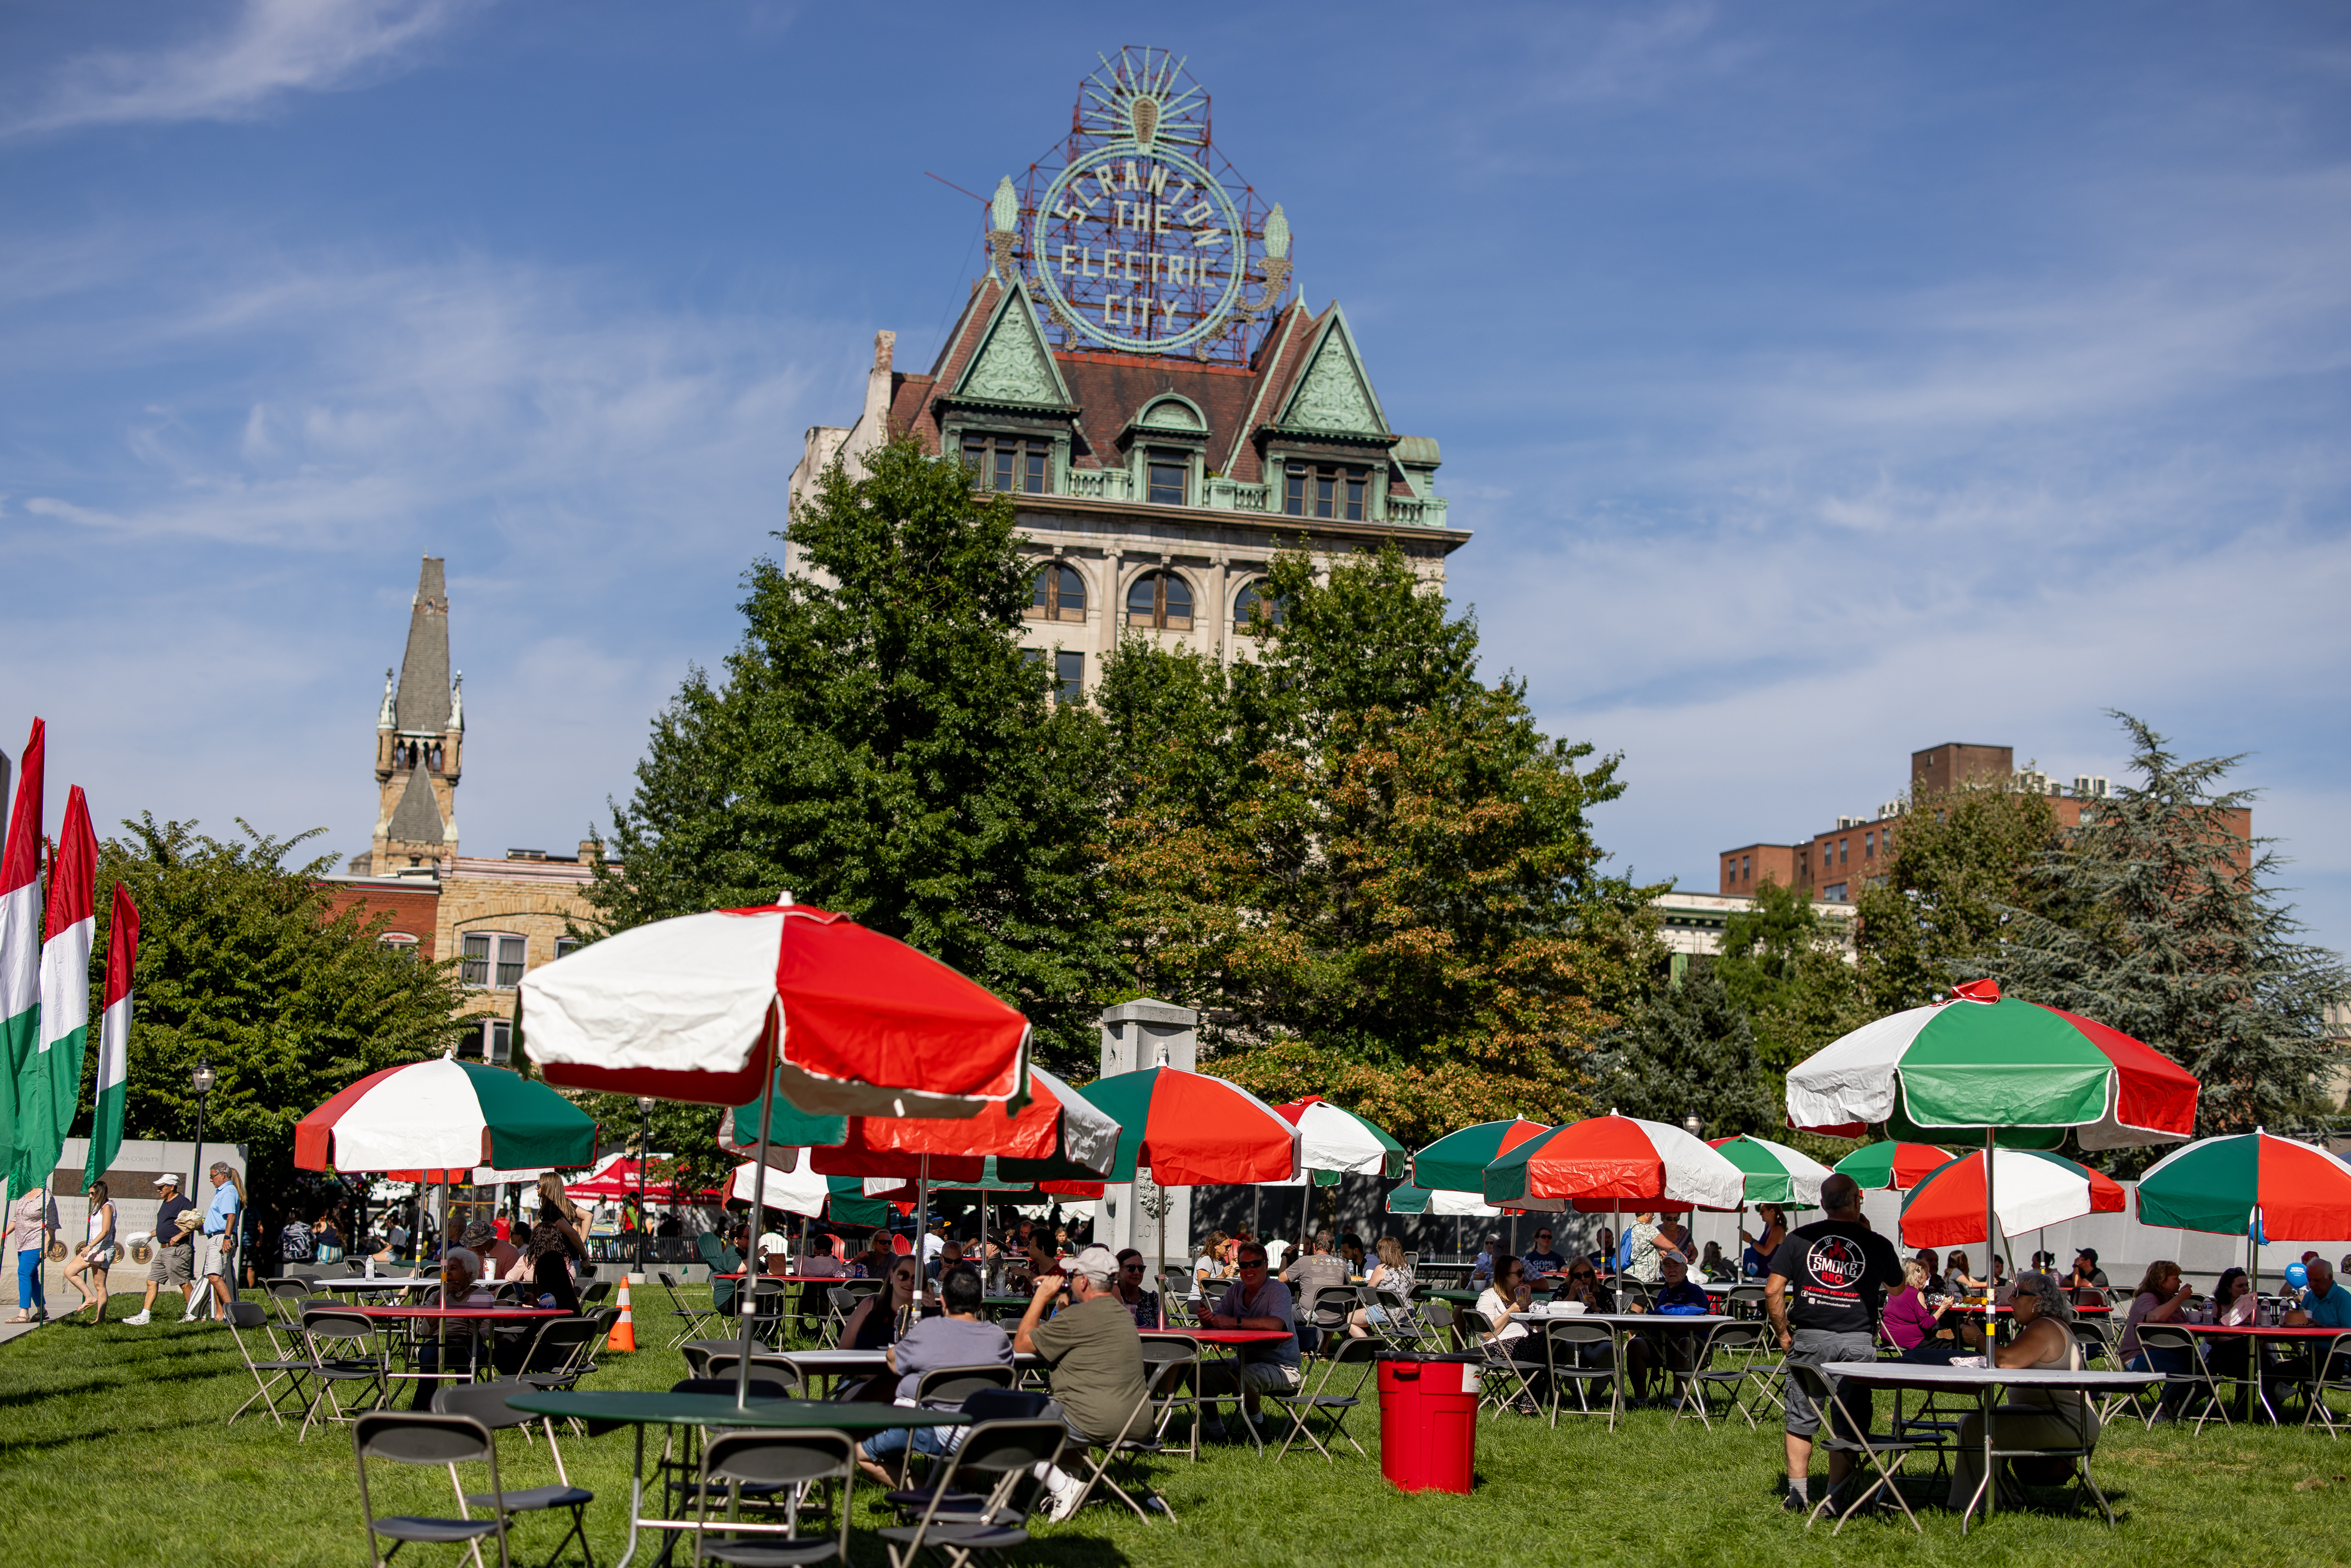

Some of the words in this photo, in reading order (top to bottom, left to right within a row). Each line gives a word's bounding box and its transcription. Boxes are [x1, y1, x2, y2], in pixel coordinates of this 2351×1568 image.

[1054, 161, 1224, 247] SCRANTON
[1114, 200, 1171, 234] THE
[1061, 244, 1216, 288] ELECTRIC
[1104, 294, 1180, 330] CITY
[1138, 1225, 1168, 1238] LOVE
[1824, 1237, 1833, 1245] UP
[1845, 1241, 1853, 1249] IN
[1813, 1257, 1857, 1275] SMOKE
[1821, 1271, 1845, 1285] BBQ
